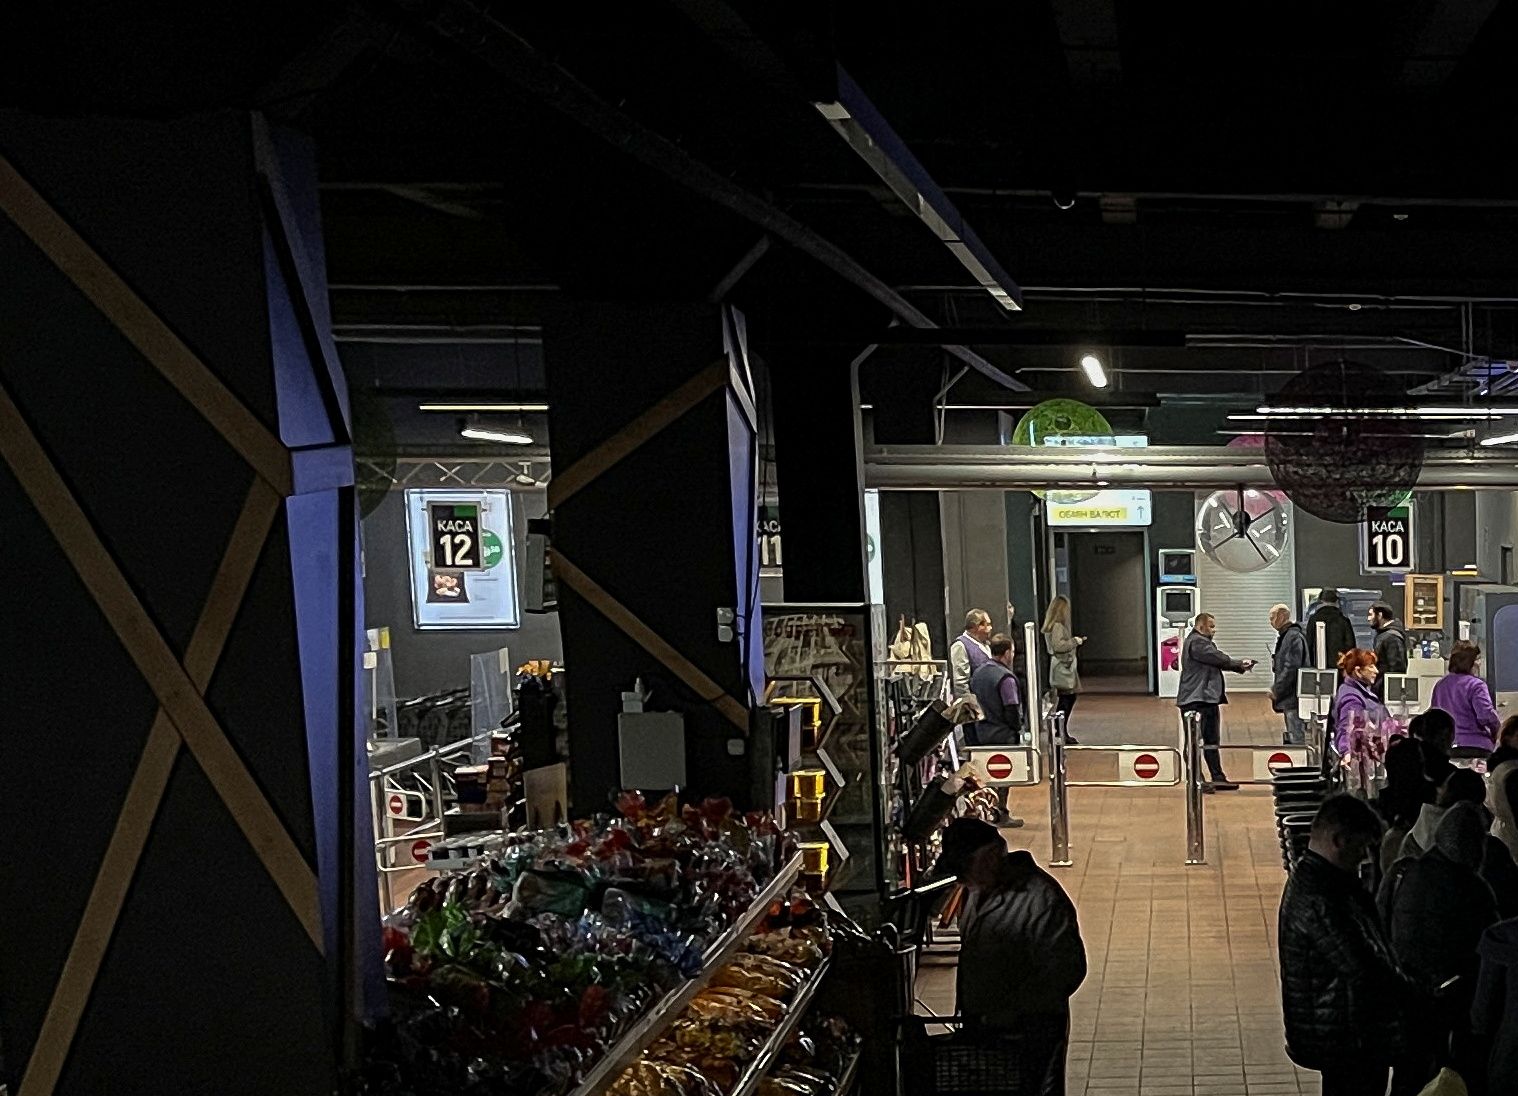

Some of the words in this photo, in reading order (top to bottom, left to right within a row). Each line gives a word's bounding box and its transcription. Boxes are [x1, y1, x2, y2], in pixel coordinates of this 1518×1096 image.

[437, 519, 473, 533] КАСА
[1371, 520, 1404, 533] КАСА
[439, 534, 473, 566] 12
[1372, 534, 1404, 565] 10
